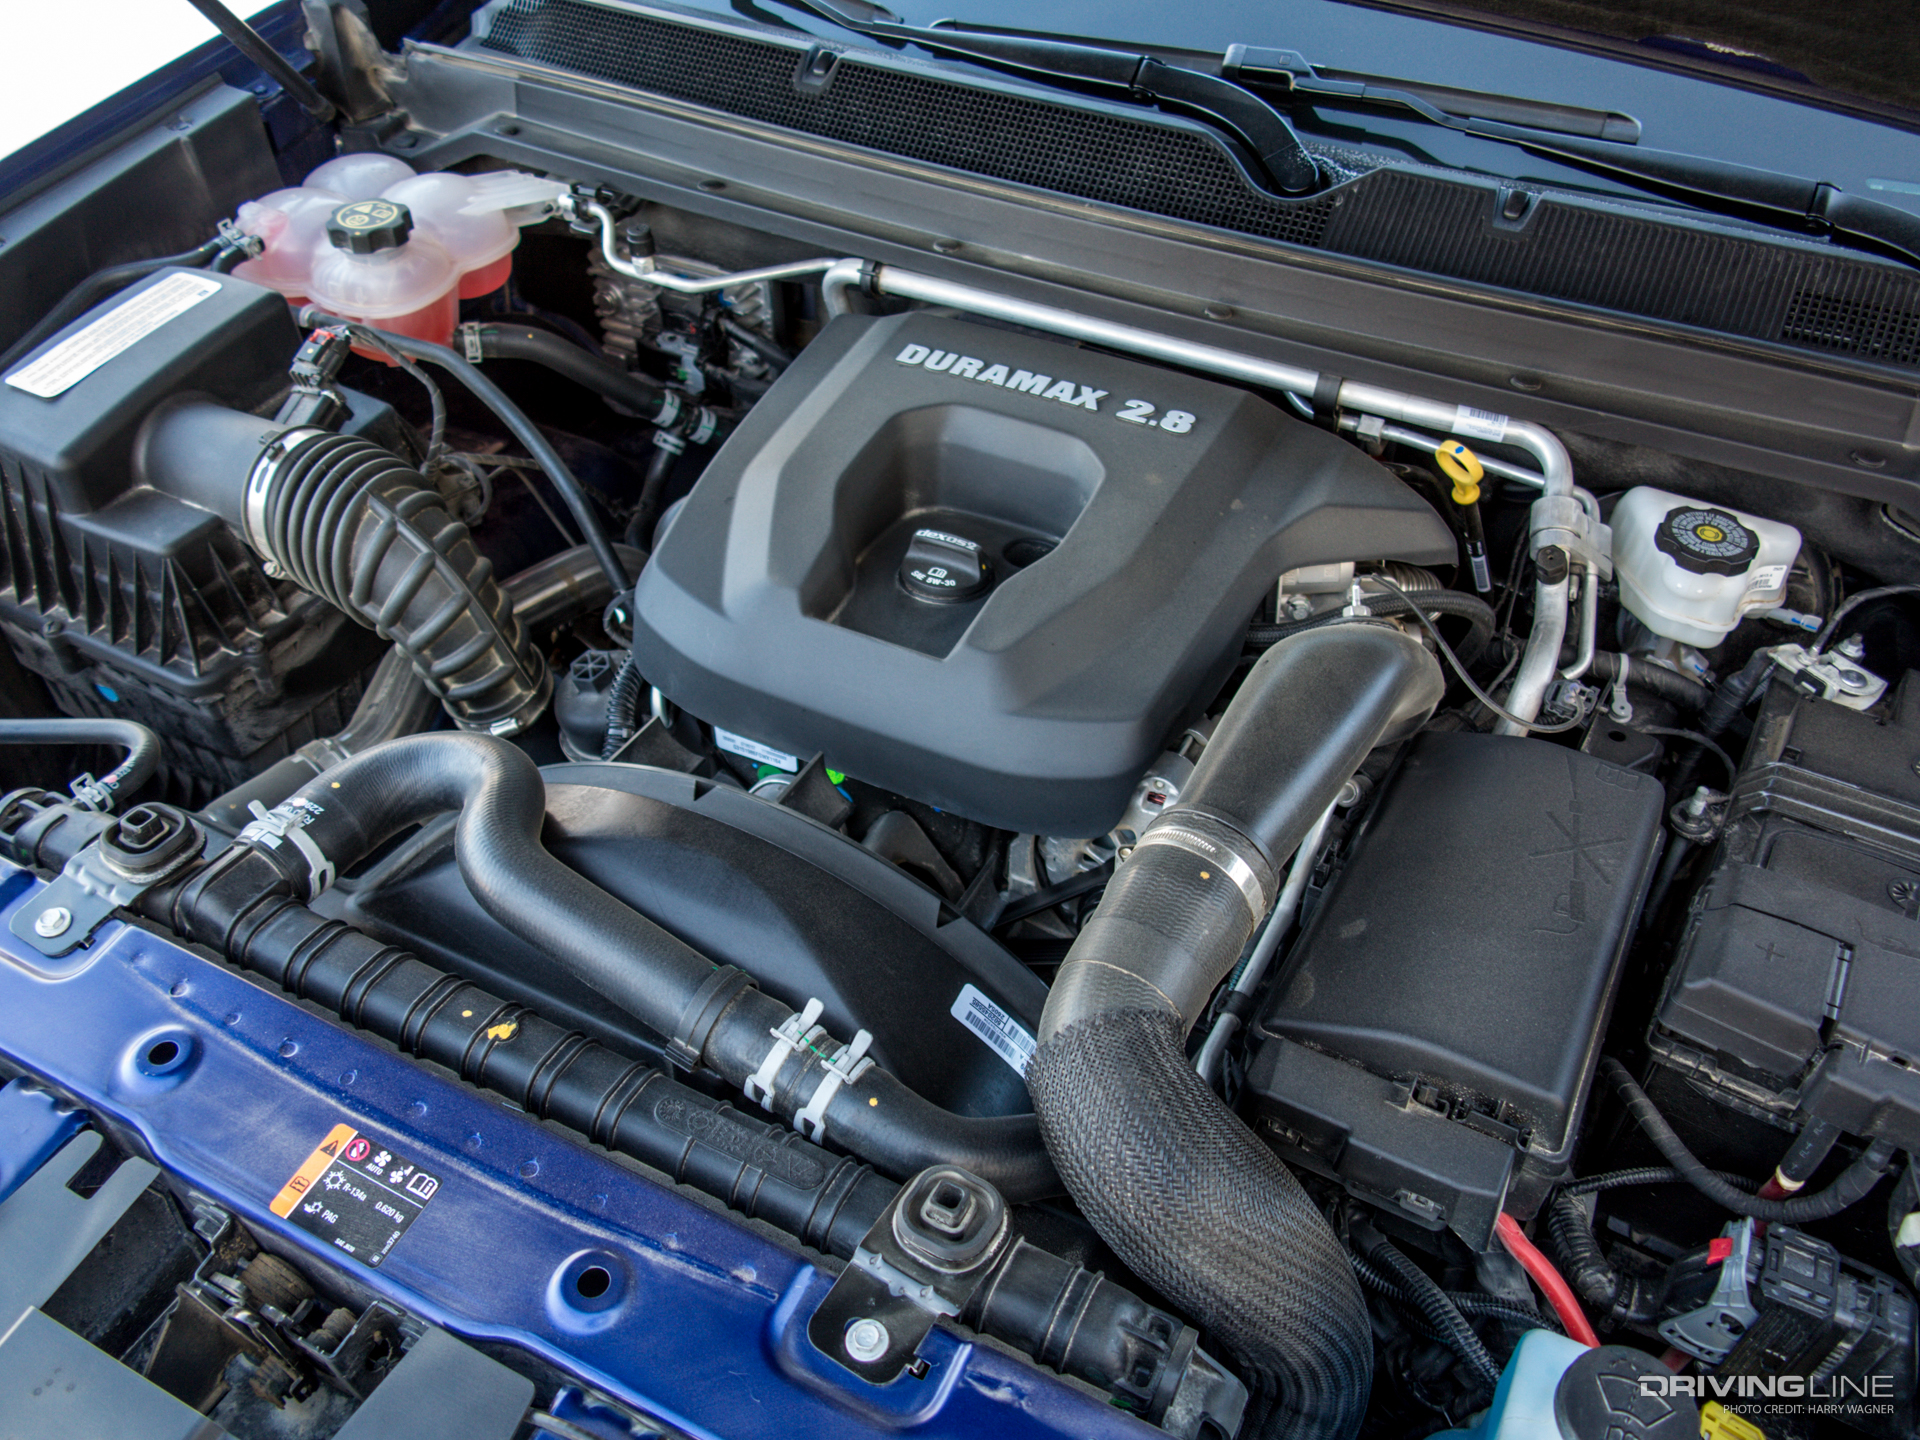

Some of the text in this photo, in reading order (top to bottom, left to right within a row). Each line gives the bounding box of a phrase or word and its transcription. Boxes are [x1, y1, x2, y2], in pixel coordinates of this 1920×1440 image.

[895, 343, 1196, 435] DURAMAX 2.8
[915, 529, 978, 551] dexos2
[926, 577, 956, 587] 5W-30
[365, 1163, 384, 1176] AUTO
[342, 1183, 368, 1202] R-134a
[321, 1209, 339, 1224] PAG
[375, 1201, 405, 1224] 0.620 kg
